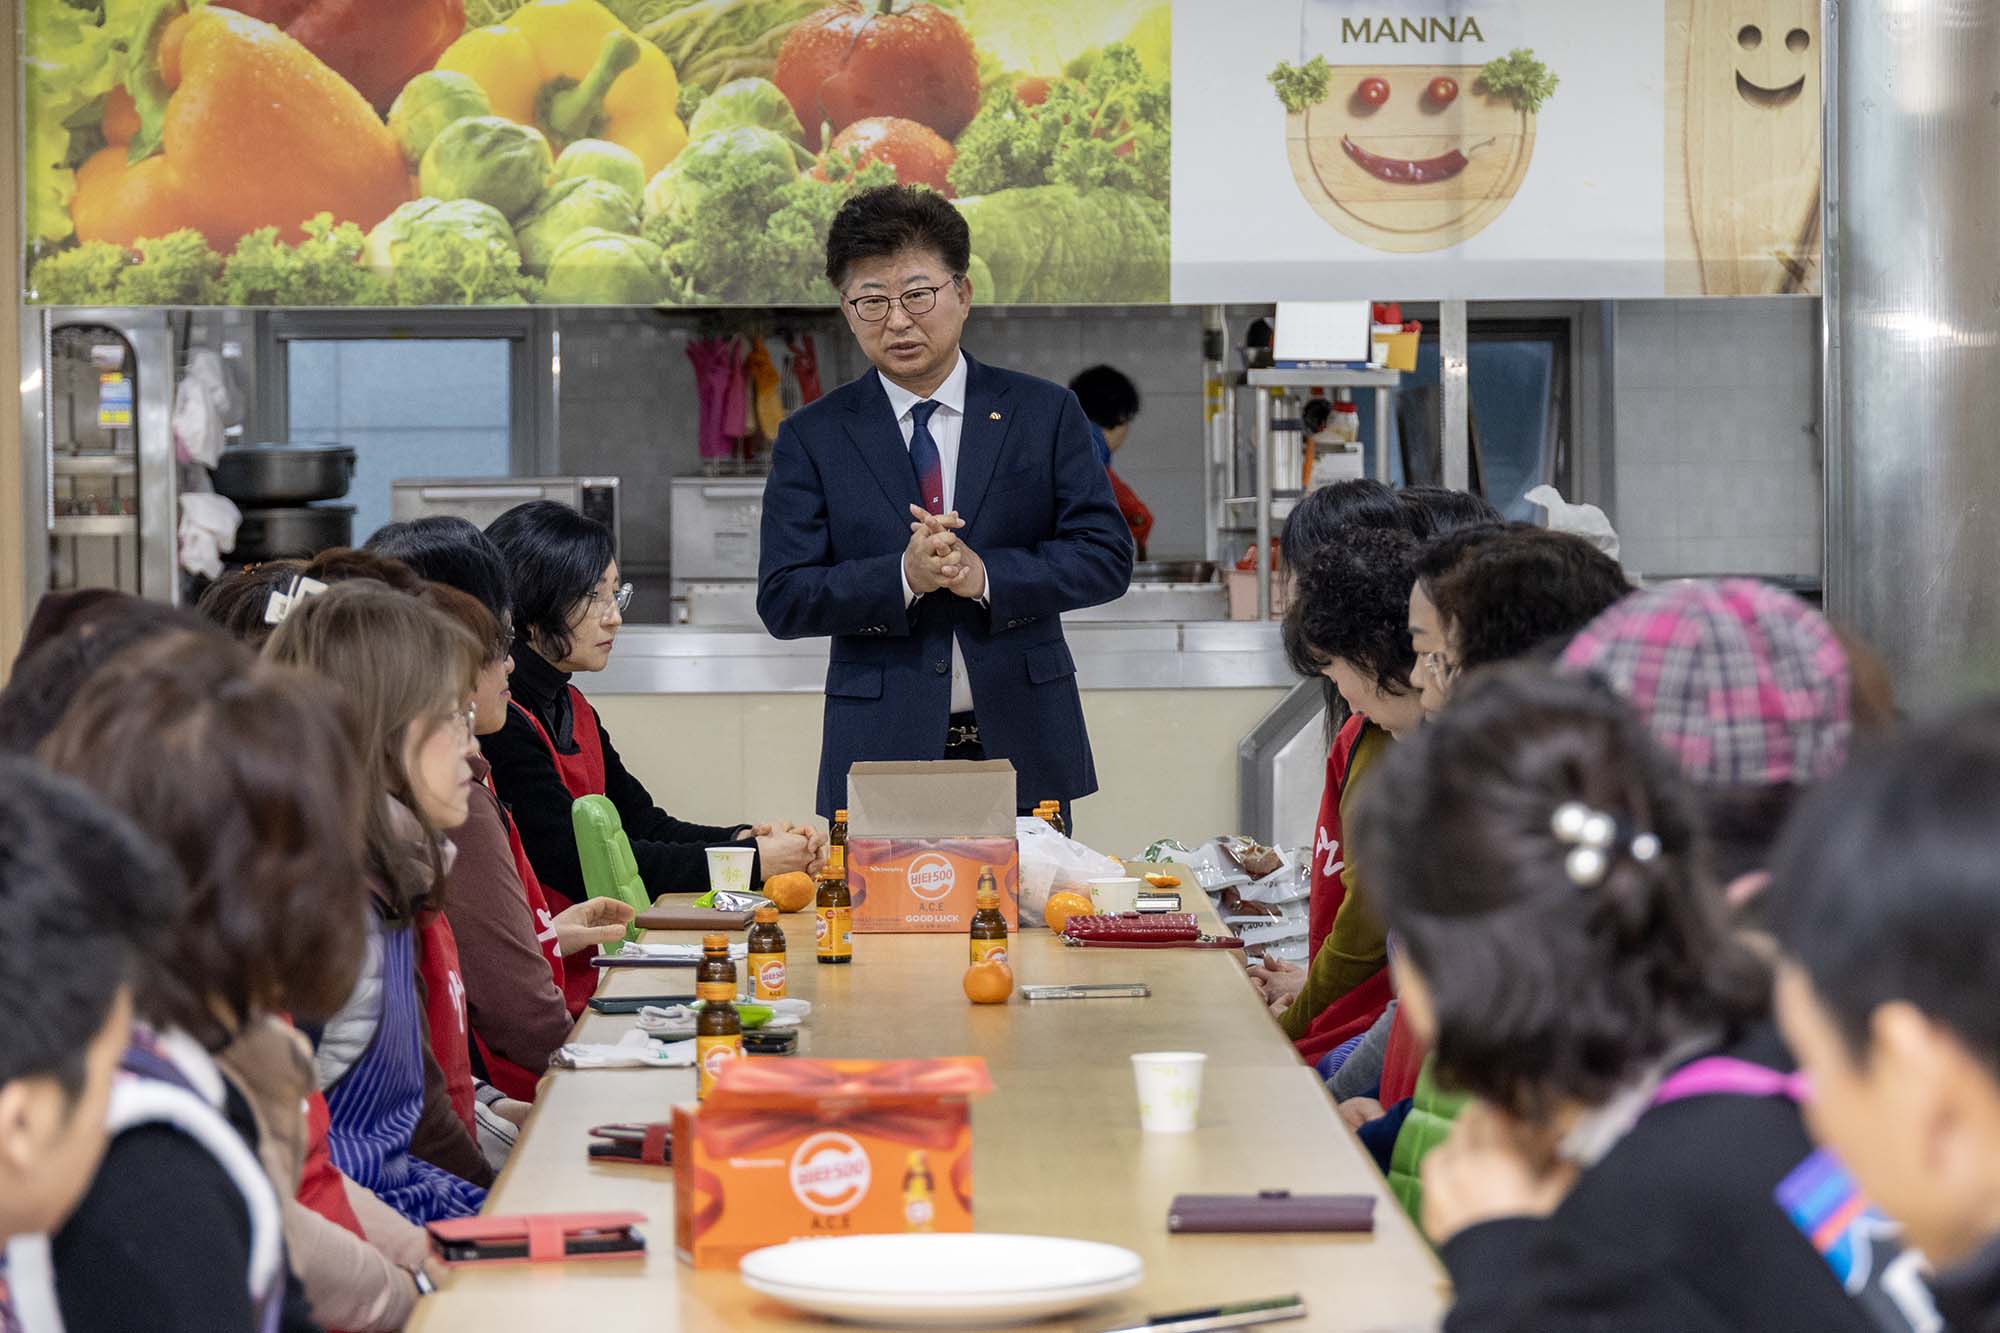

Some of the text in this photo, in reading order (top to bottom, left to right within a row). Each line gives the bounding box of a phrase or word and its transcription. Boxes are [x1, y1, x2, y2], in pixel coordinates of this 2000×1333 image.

[1341, 17, 1485, 44] MANNA
[911, 869, 953, 885] 비타500
[905, 914, 960, 923] GOOD LUCK
